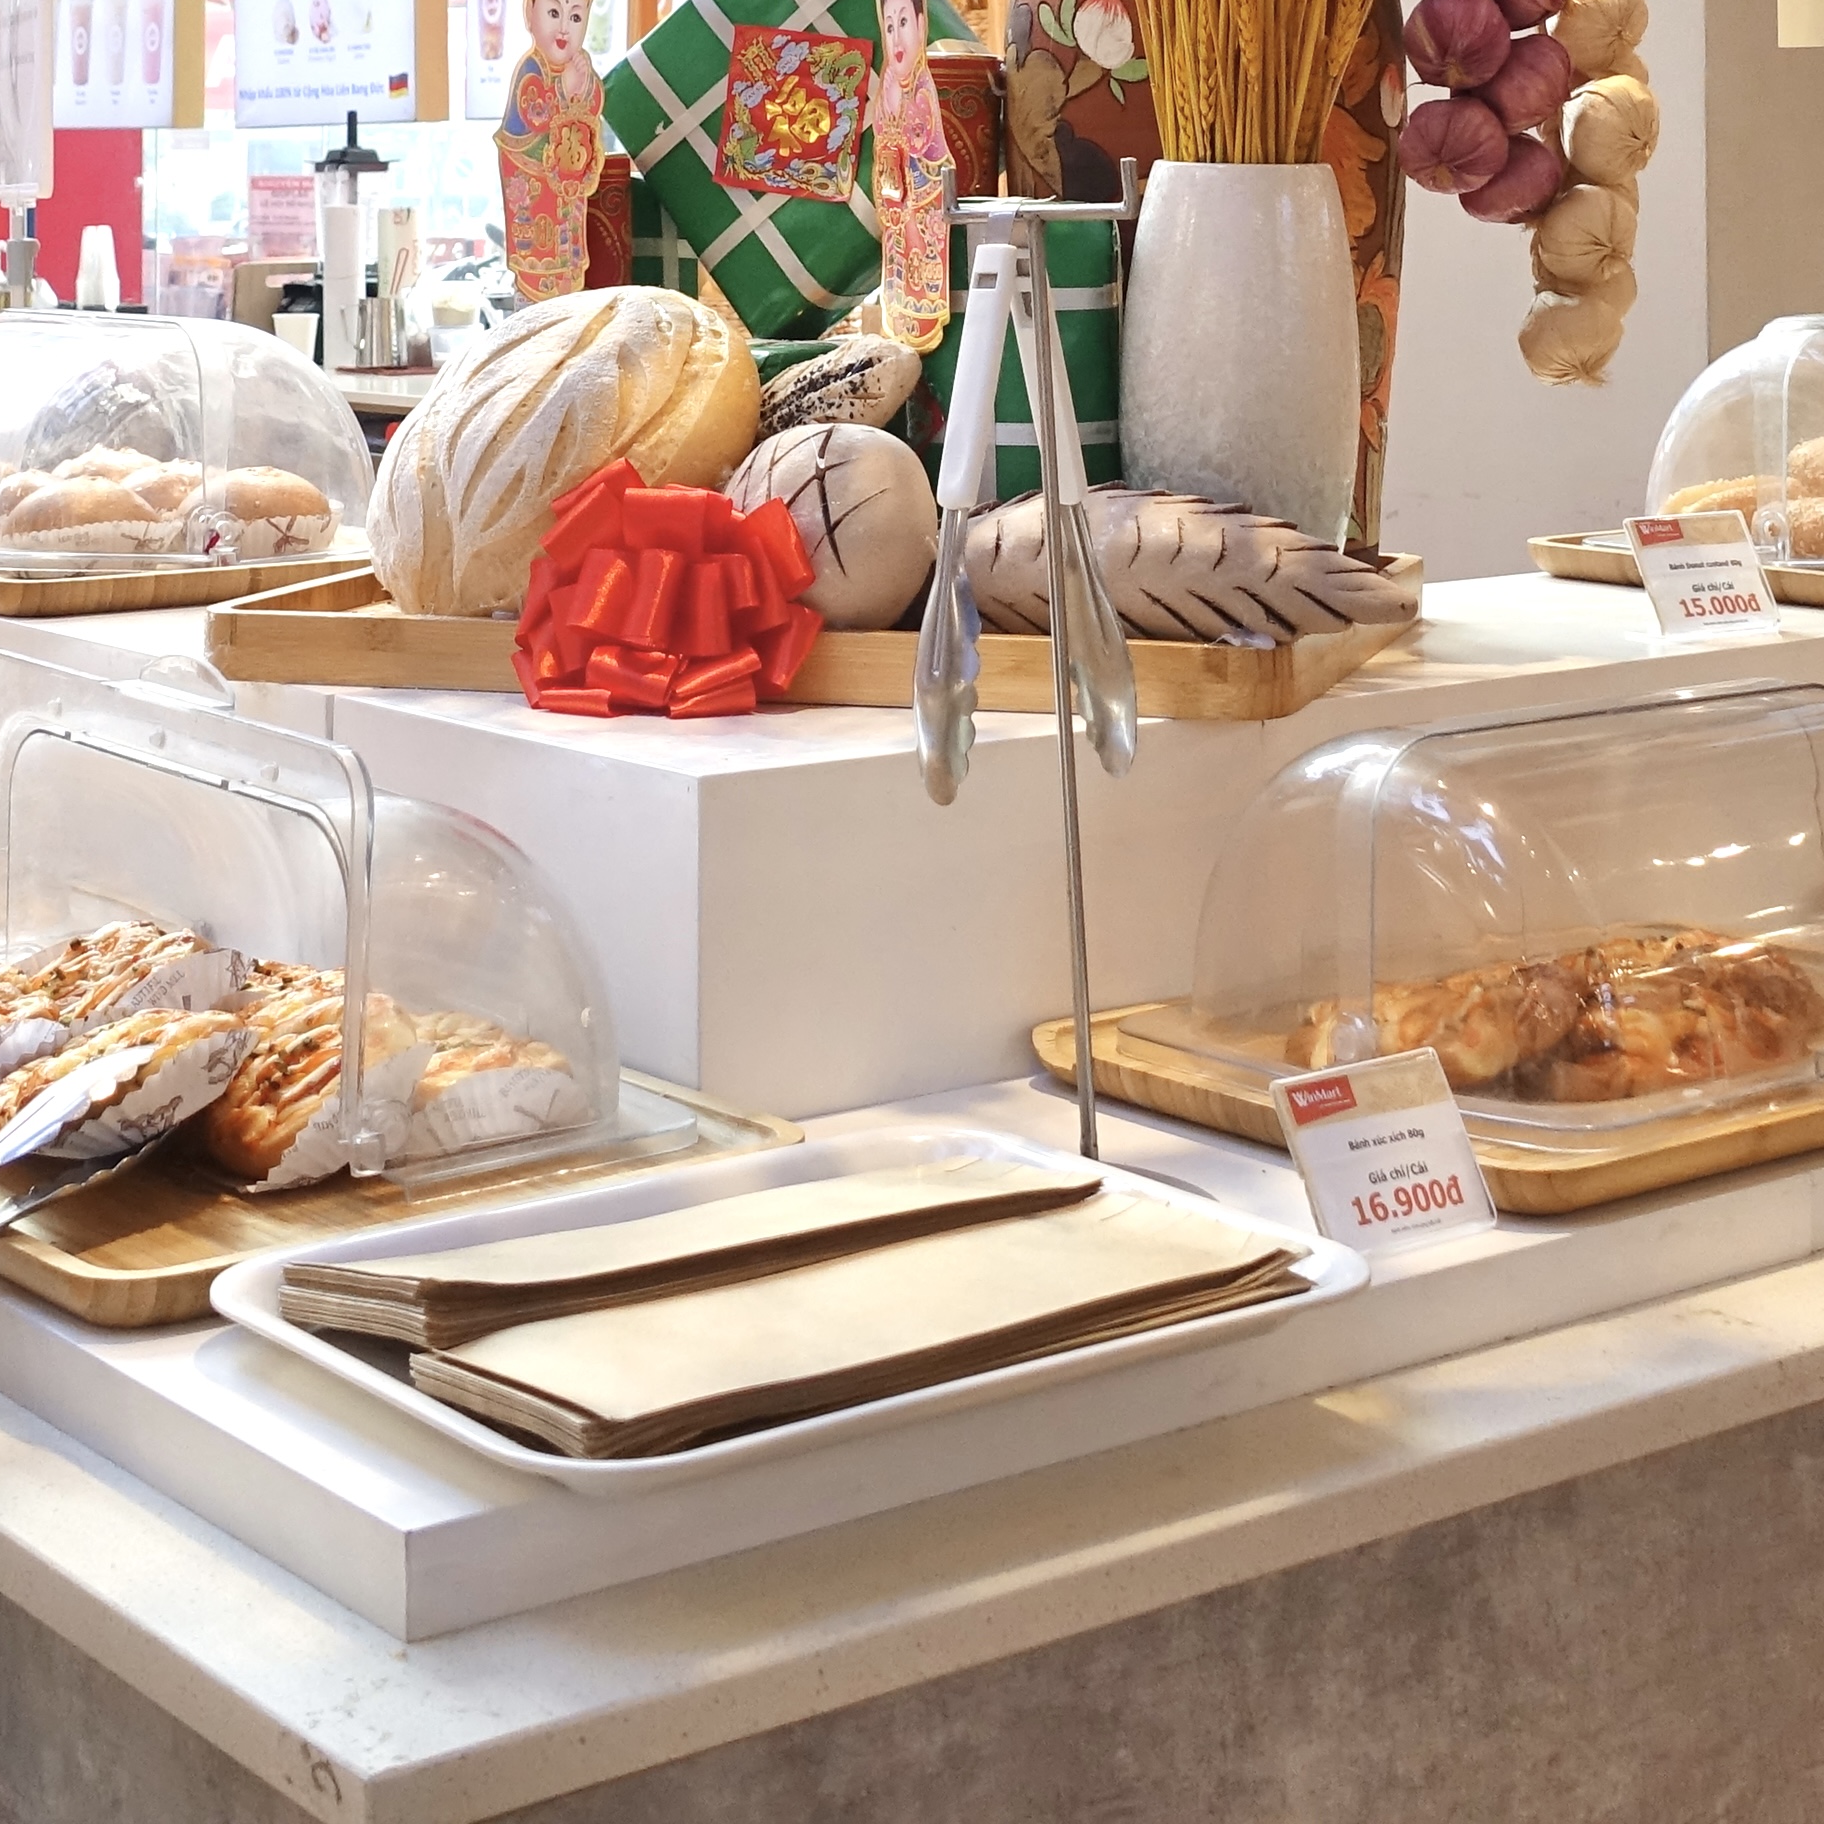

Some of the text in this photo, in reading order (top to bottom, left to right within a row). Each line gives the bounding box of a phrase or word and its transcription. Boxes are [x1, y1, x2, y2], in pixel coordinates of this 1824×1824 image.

[1679, 592, 1761, 618] 15.000đ
[1292, 1085, 1343, 1108] WinMart
[1348, 1136, 1371, 1151] Bánh
[1368, 1168, 1387, 1184] Giá
[1351, 1173, 1465, 1227] 16.900đ
